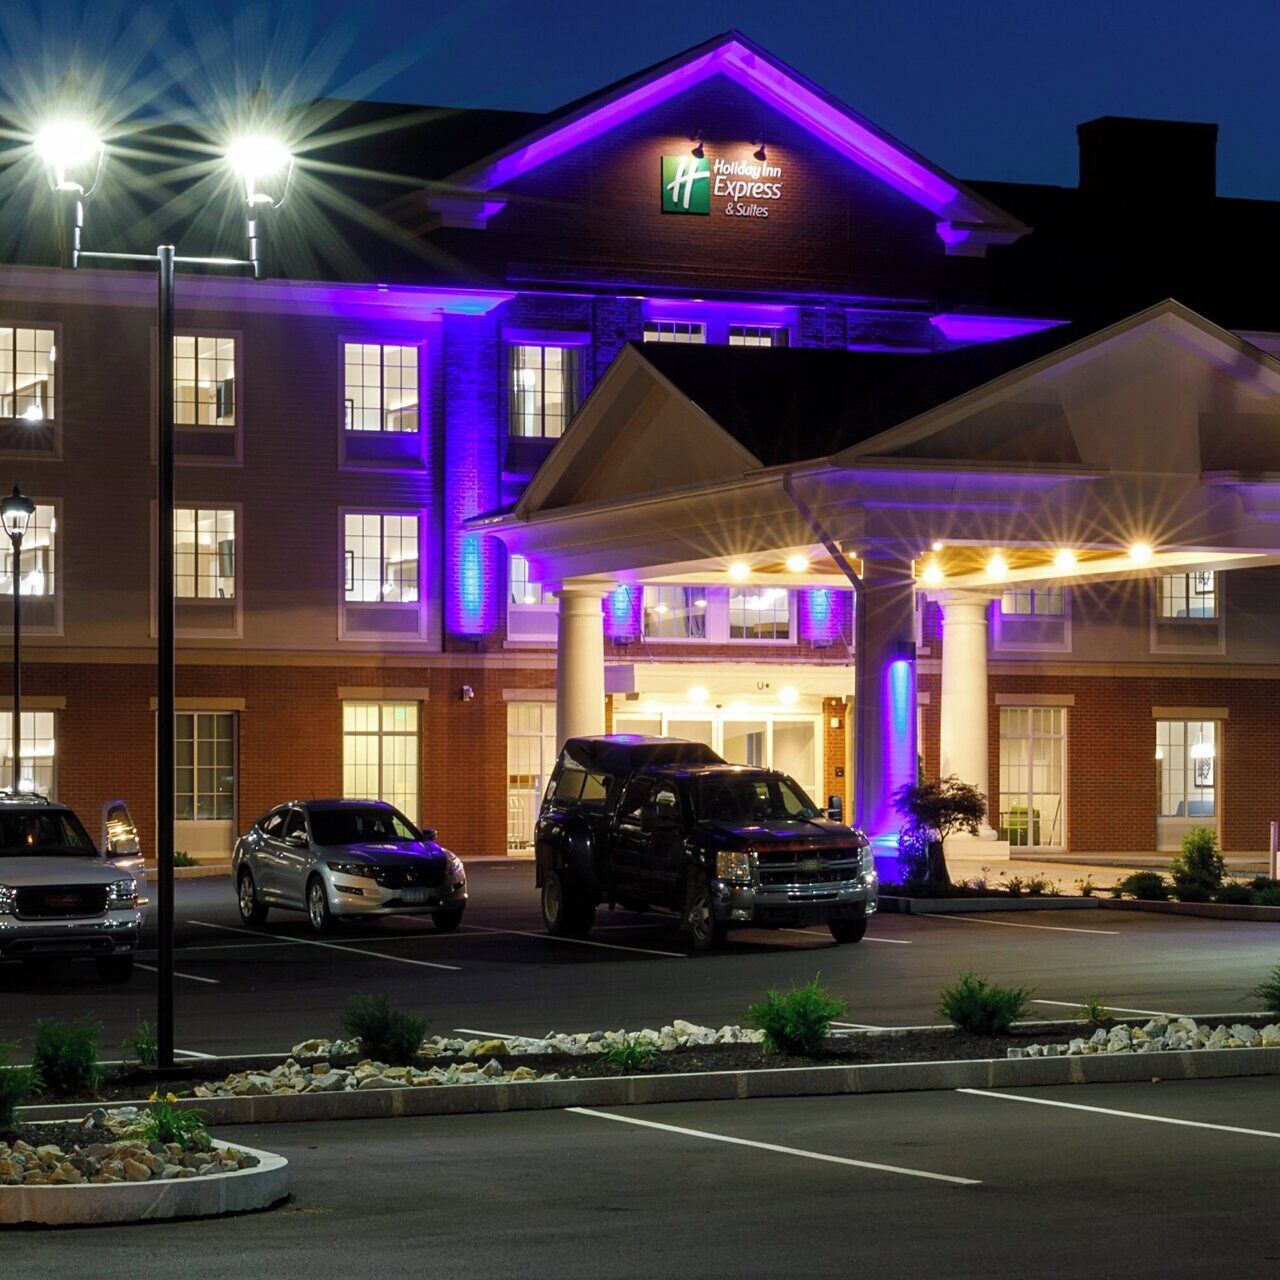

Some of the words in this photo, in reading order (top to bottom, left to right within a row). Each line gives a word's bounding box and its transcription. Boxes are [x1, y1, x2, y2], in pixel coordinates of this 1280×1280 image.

[713, 158, 761, 179] Holiday
[761, 161, 782, 178] Inn
[713, 176, 782, 202] Express
[725, 203, 735, 216] &
[735, 202, 769, 218] Suites
